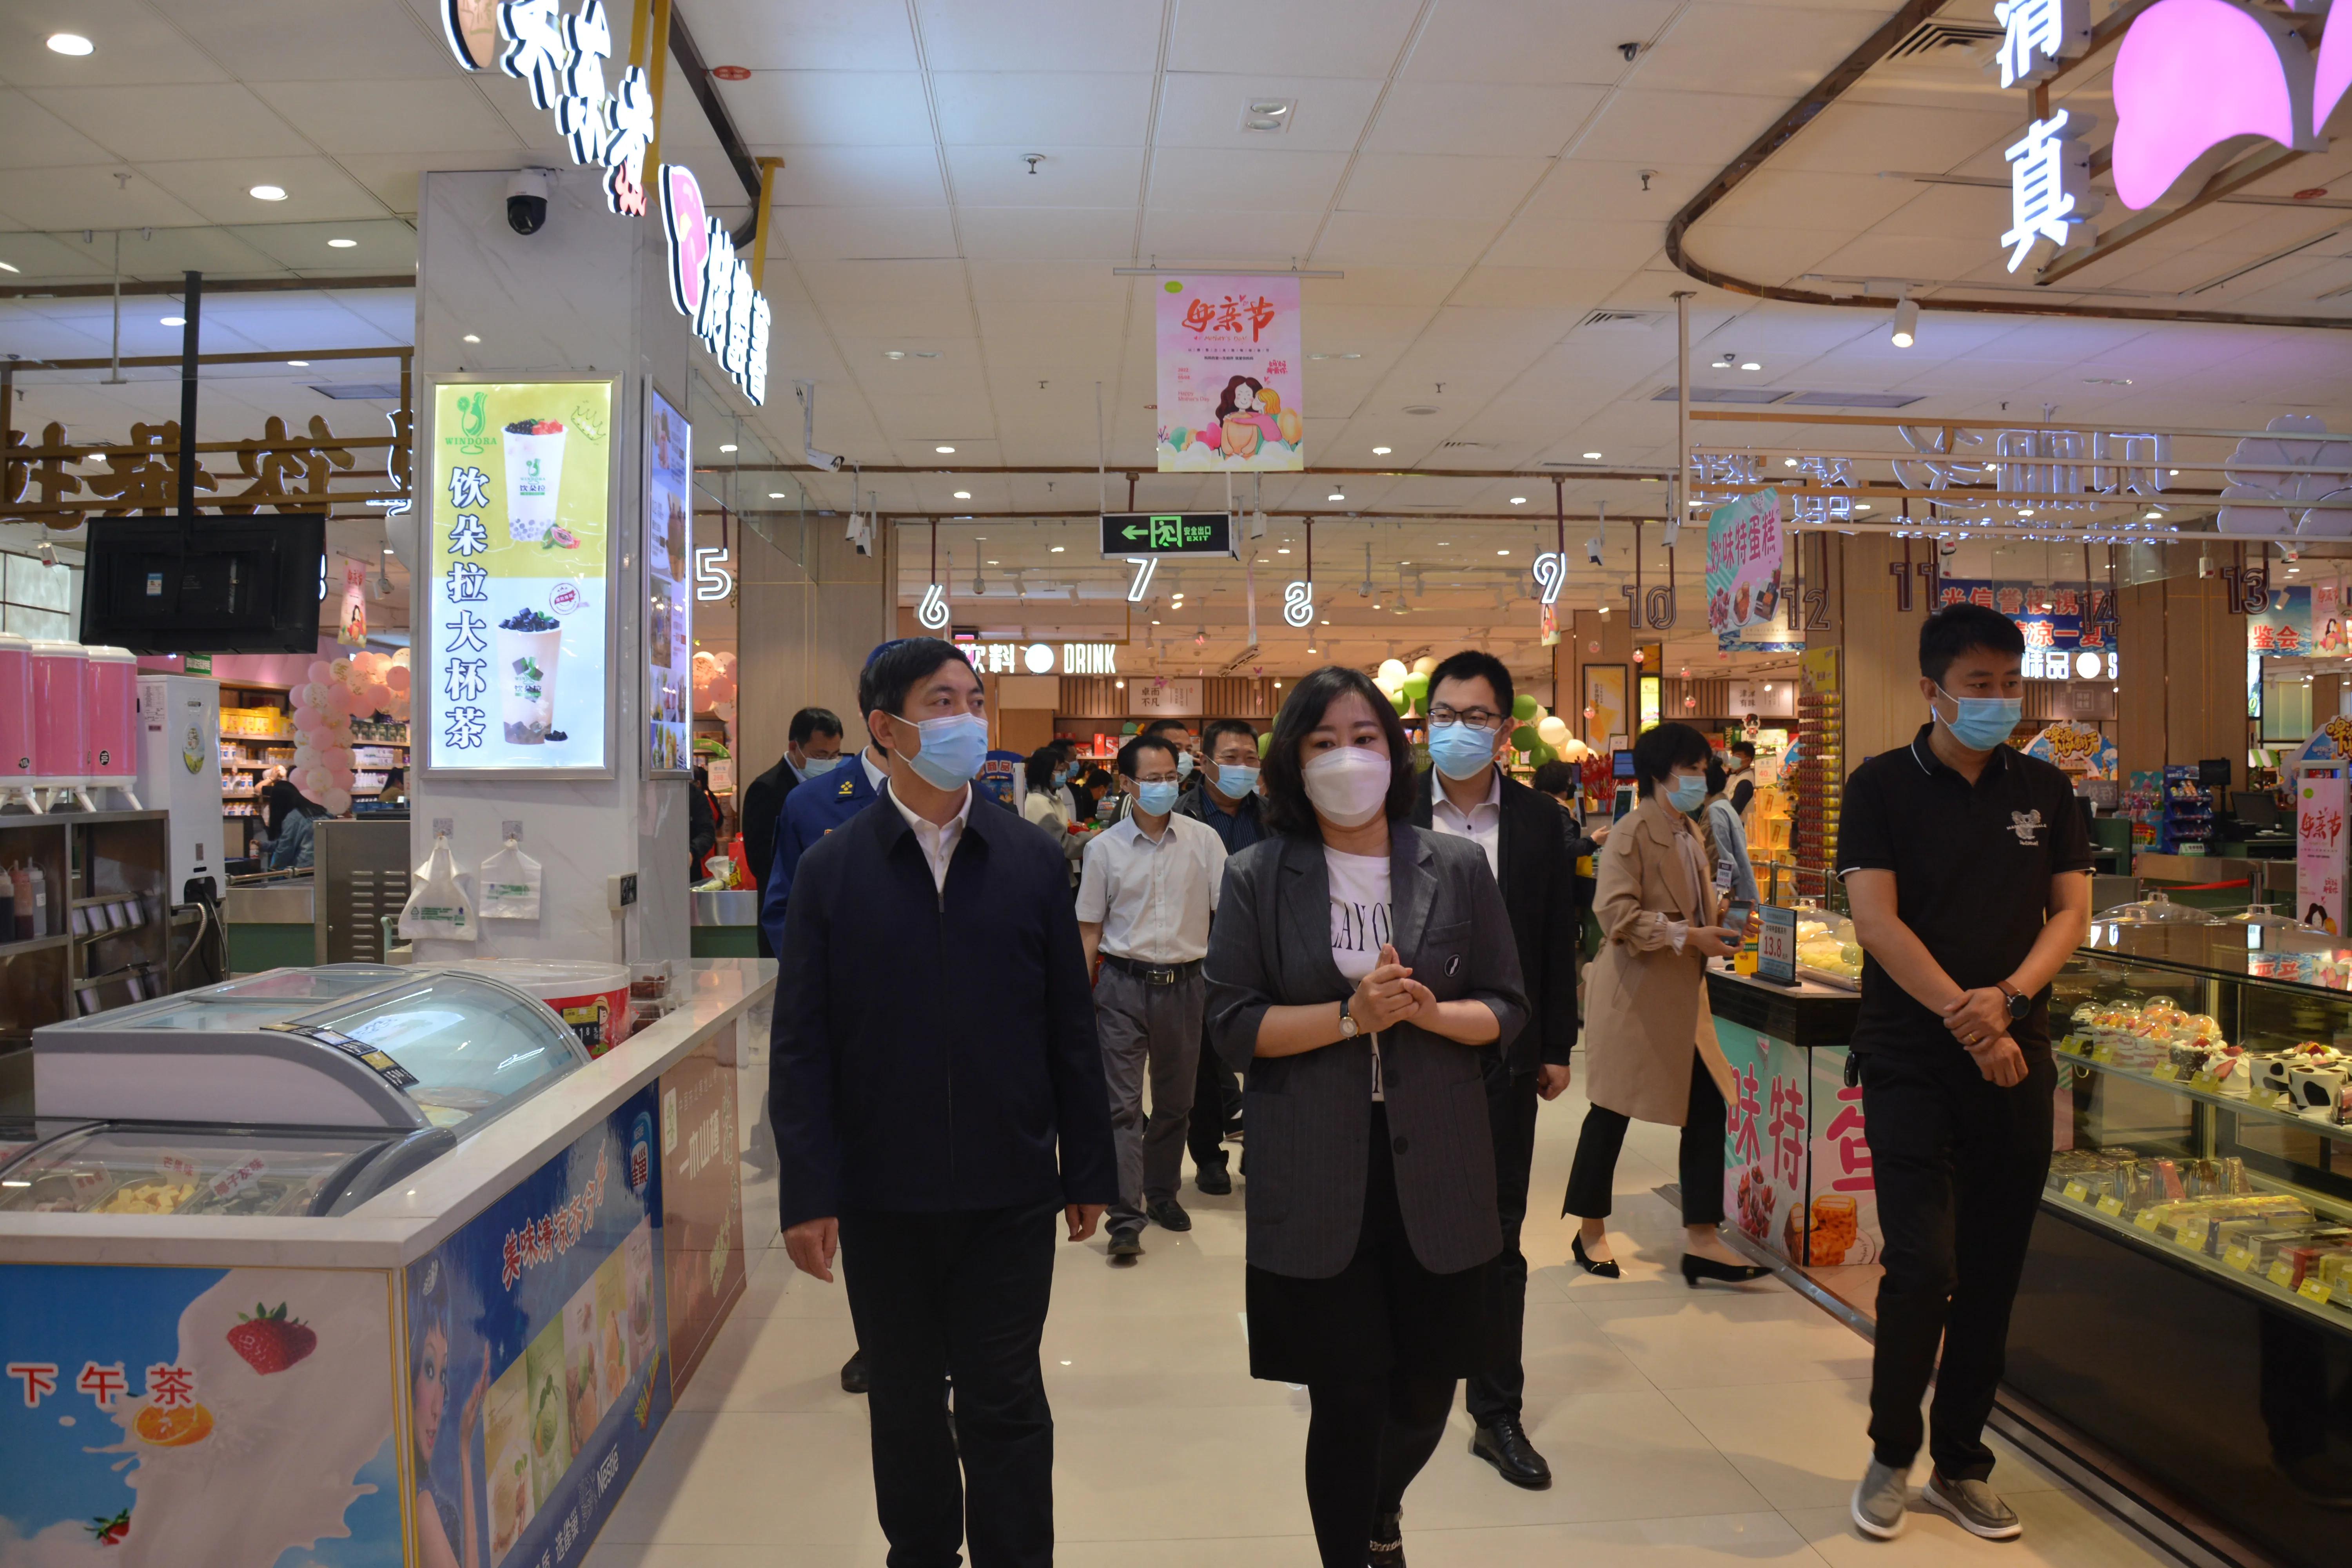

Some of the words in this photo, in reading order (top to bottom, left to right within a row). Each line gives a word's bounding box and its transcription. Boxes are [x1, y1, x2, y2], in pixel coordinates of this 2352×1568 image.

[1181, 296, 1274, 342] 母亲节
[445, 437, 497, 445] WINDORA
[1184, 526, 1211, 535] 安全出口
[1710, 510, 1776, 574] 妙味特蛋糕
[695, 548, 732, 601] 5
[1127, 557, 1157, 601] 7
[1533, 552, 1566, 604] 9
[1889, 563, 1940, 612] 11
[2221, 566, 2270, 614] 13
[446, 466, 490, 750] 饮朵拉大杯茶
[919, 584, 949, 629] 6
[1284, 582, 1313, 627] 8
[1622, 585, 1676, 629] 10
[1780, 587, 1831, 631] 12
[1064, 644, 1116, 673] DRINK
[2254, 625, 2299, 649] 鉴会
[1142, 687, 1160, 696] 卓而
[1142, 698, 1160, 706] 不凡
[985, 760, 1012, 774] 商品
[2299, 810, 2342, 847] 母亲节
[1372, 903, 1392, 951] O
[1764, 936, 1782, 958] 13.8
[679, 1109, 719, 1180] 一木山楂
[1727, 1062, 1805, 1191] 味特
[632, 1146, 648, 1187] 雀巢
[10, 1364, 195, 1406] 下午茶
[555, 1506, 579, 1564] 选雀巢
